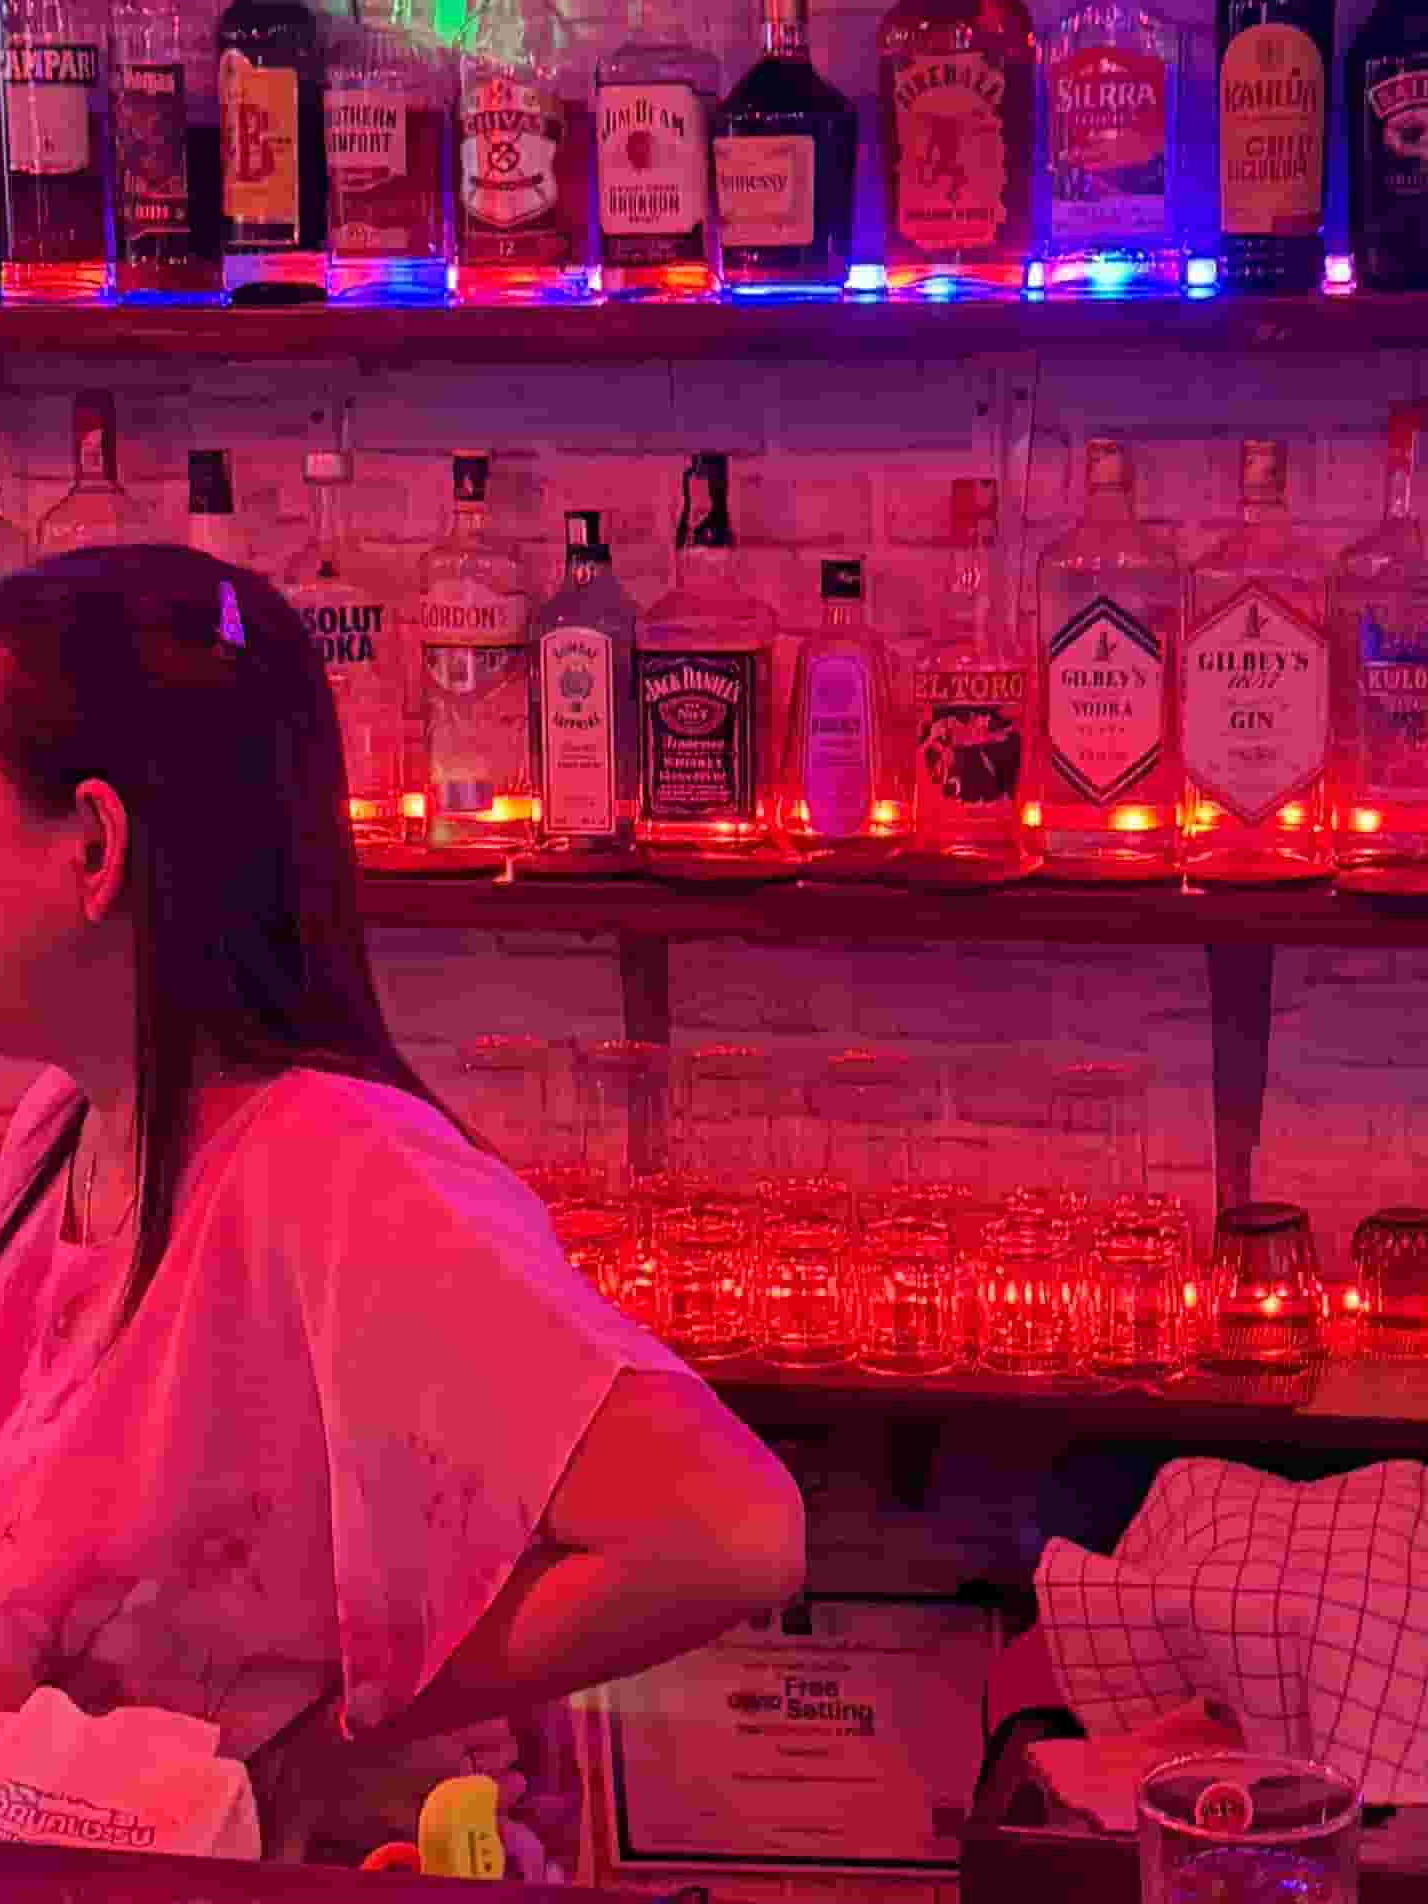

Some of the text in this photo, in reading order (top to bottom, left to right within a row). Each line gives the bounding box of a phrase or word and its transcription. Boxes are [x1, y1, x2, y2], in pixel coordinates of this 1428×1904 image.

[302, 604, 381, 633] SOLUT
[1196, 649, 1310, 674] GILBEY'S
[644, 671, 683, 704] JACK
[1227, 709, 1275, 730] GIN
